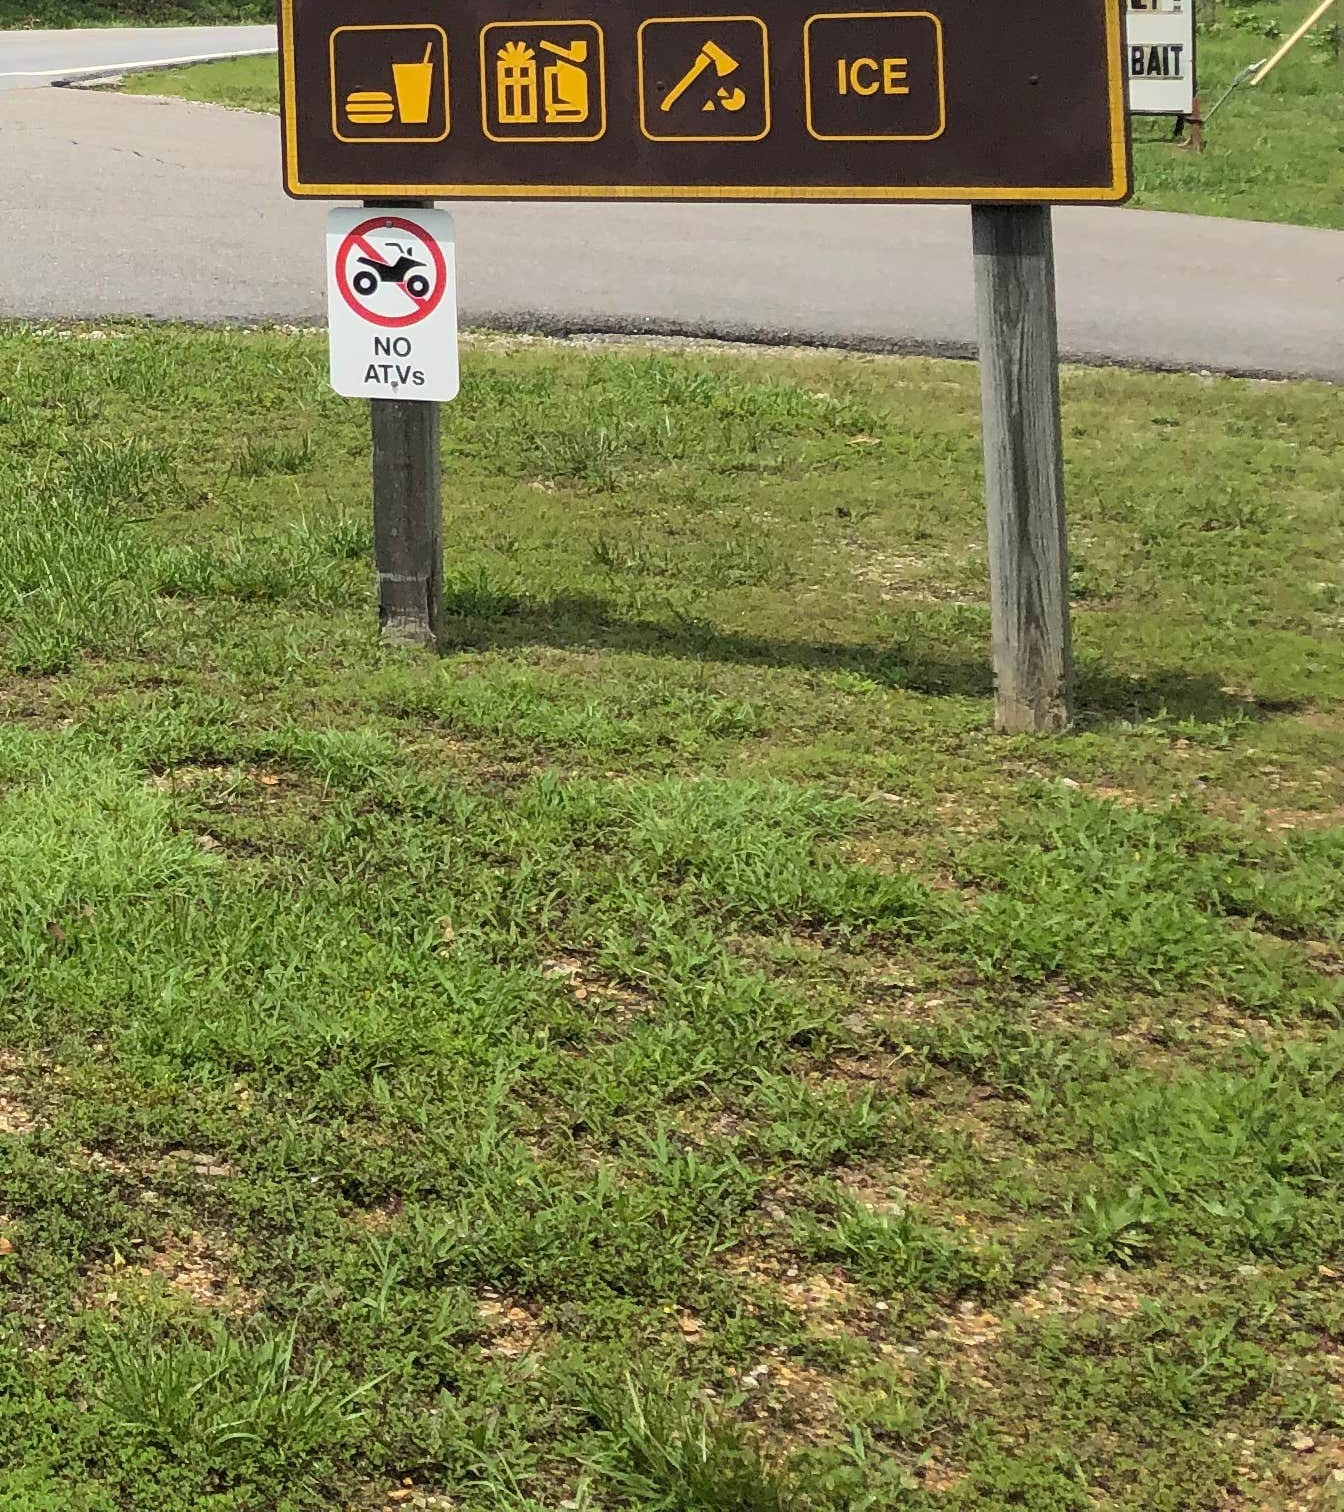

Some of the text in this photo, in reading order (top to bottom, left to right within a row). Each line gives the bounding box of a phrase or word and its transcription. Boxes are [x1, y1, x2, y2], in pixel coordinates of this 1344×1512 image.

[1131, 45, 1184, 76] BAIT
[837, 57, 910, 96] ICE
[374, 336, 412, 358] NO
[363, 363, 426, 386] ATVs
